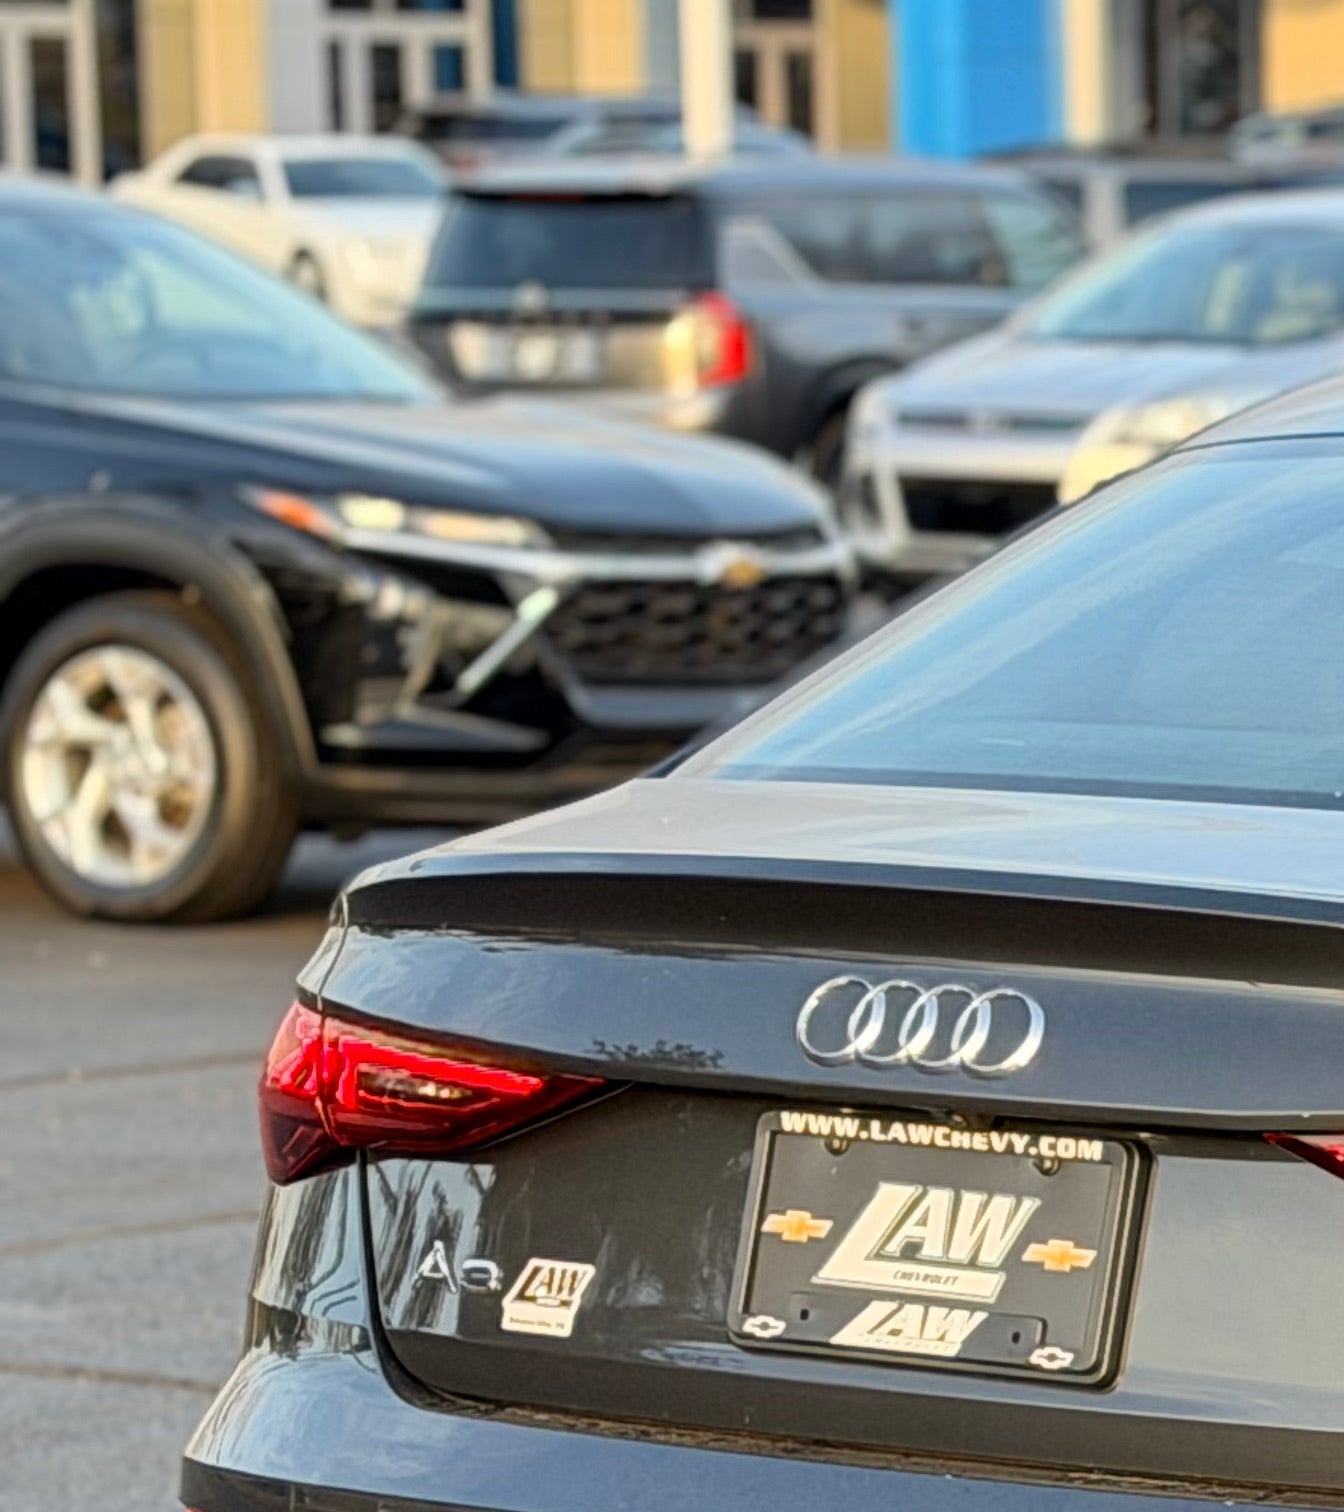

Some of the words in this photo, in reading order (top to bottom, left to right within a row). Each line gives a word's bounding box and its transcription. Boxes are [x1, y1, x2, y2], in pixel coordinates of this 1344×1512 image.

[780, 1111, 1104, 1161] WWW.LAWCHEVY.COM
[811, 1181, 1041, 1304] LAW
[892, 1269, 960, 1287] CHEVROLET
[829, 1300, 989, 1357] LAW
